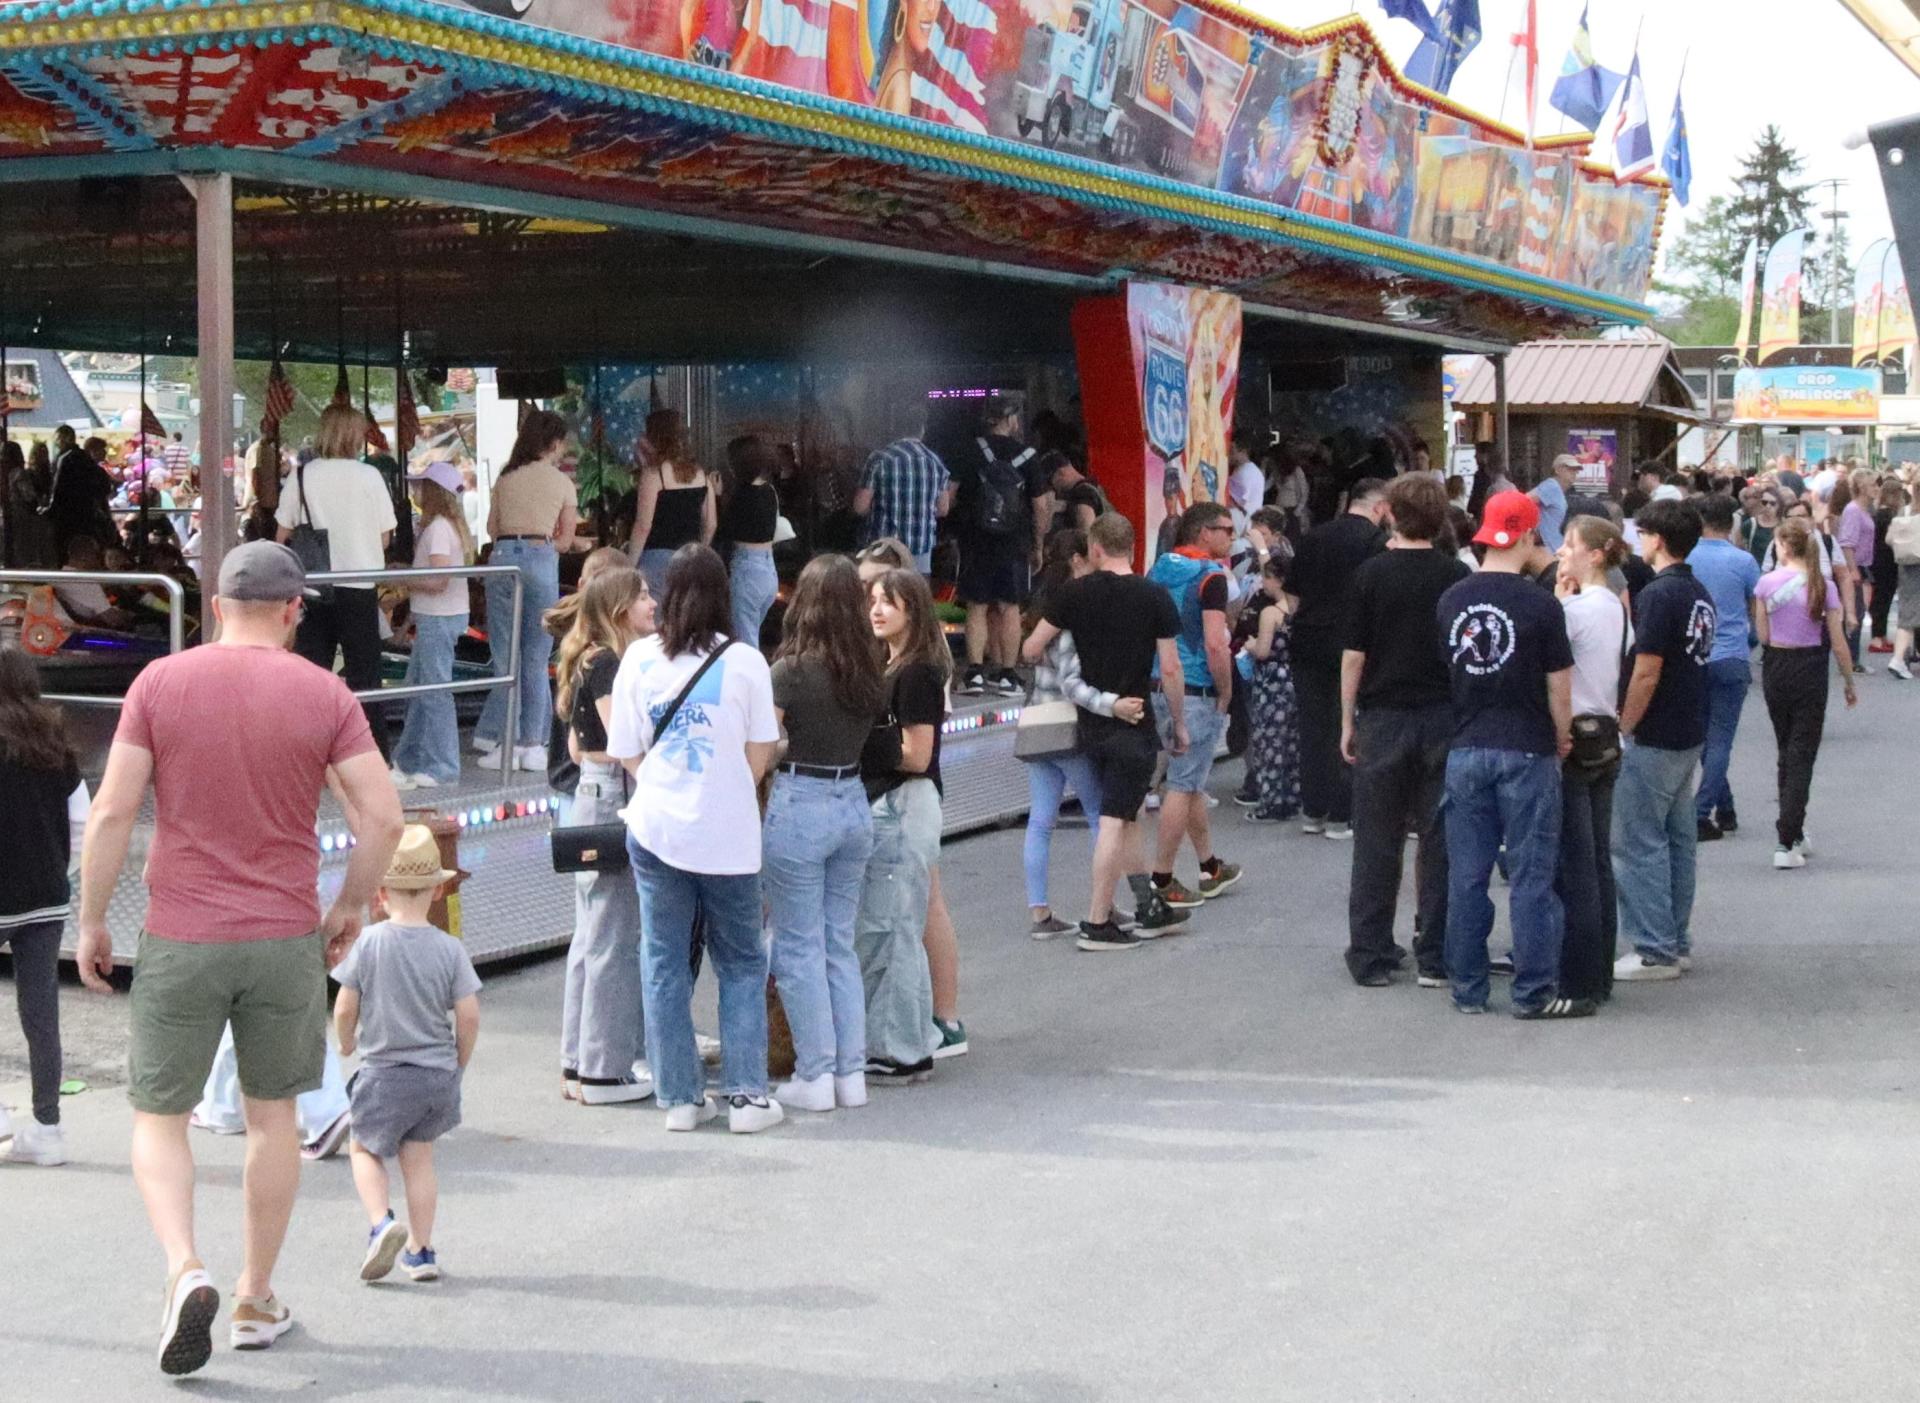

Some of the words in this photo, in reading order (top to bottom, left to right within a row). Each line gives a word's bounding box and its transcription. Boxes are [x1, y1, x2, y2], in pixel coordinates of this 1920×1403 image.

[1151, 355, 1183, 388] ROUTE
[1797, 373, 1836, 385] DROP
[1153, 384, 1183, 444] 66
